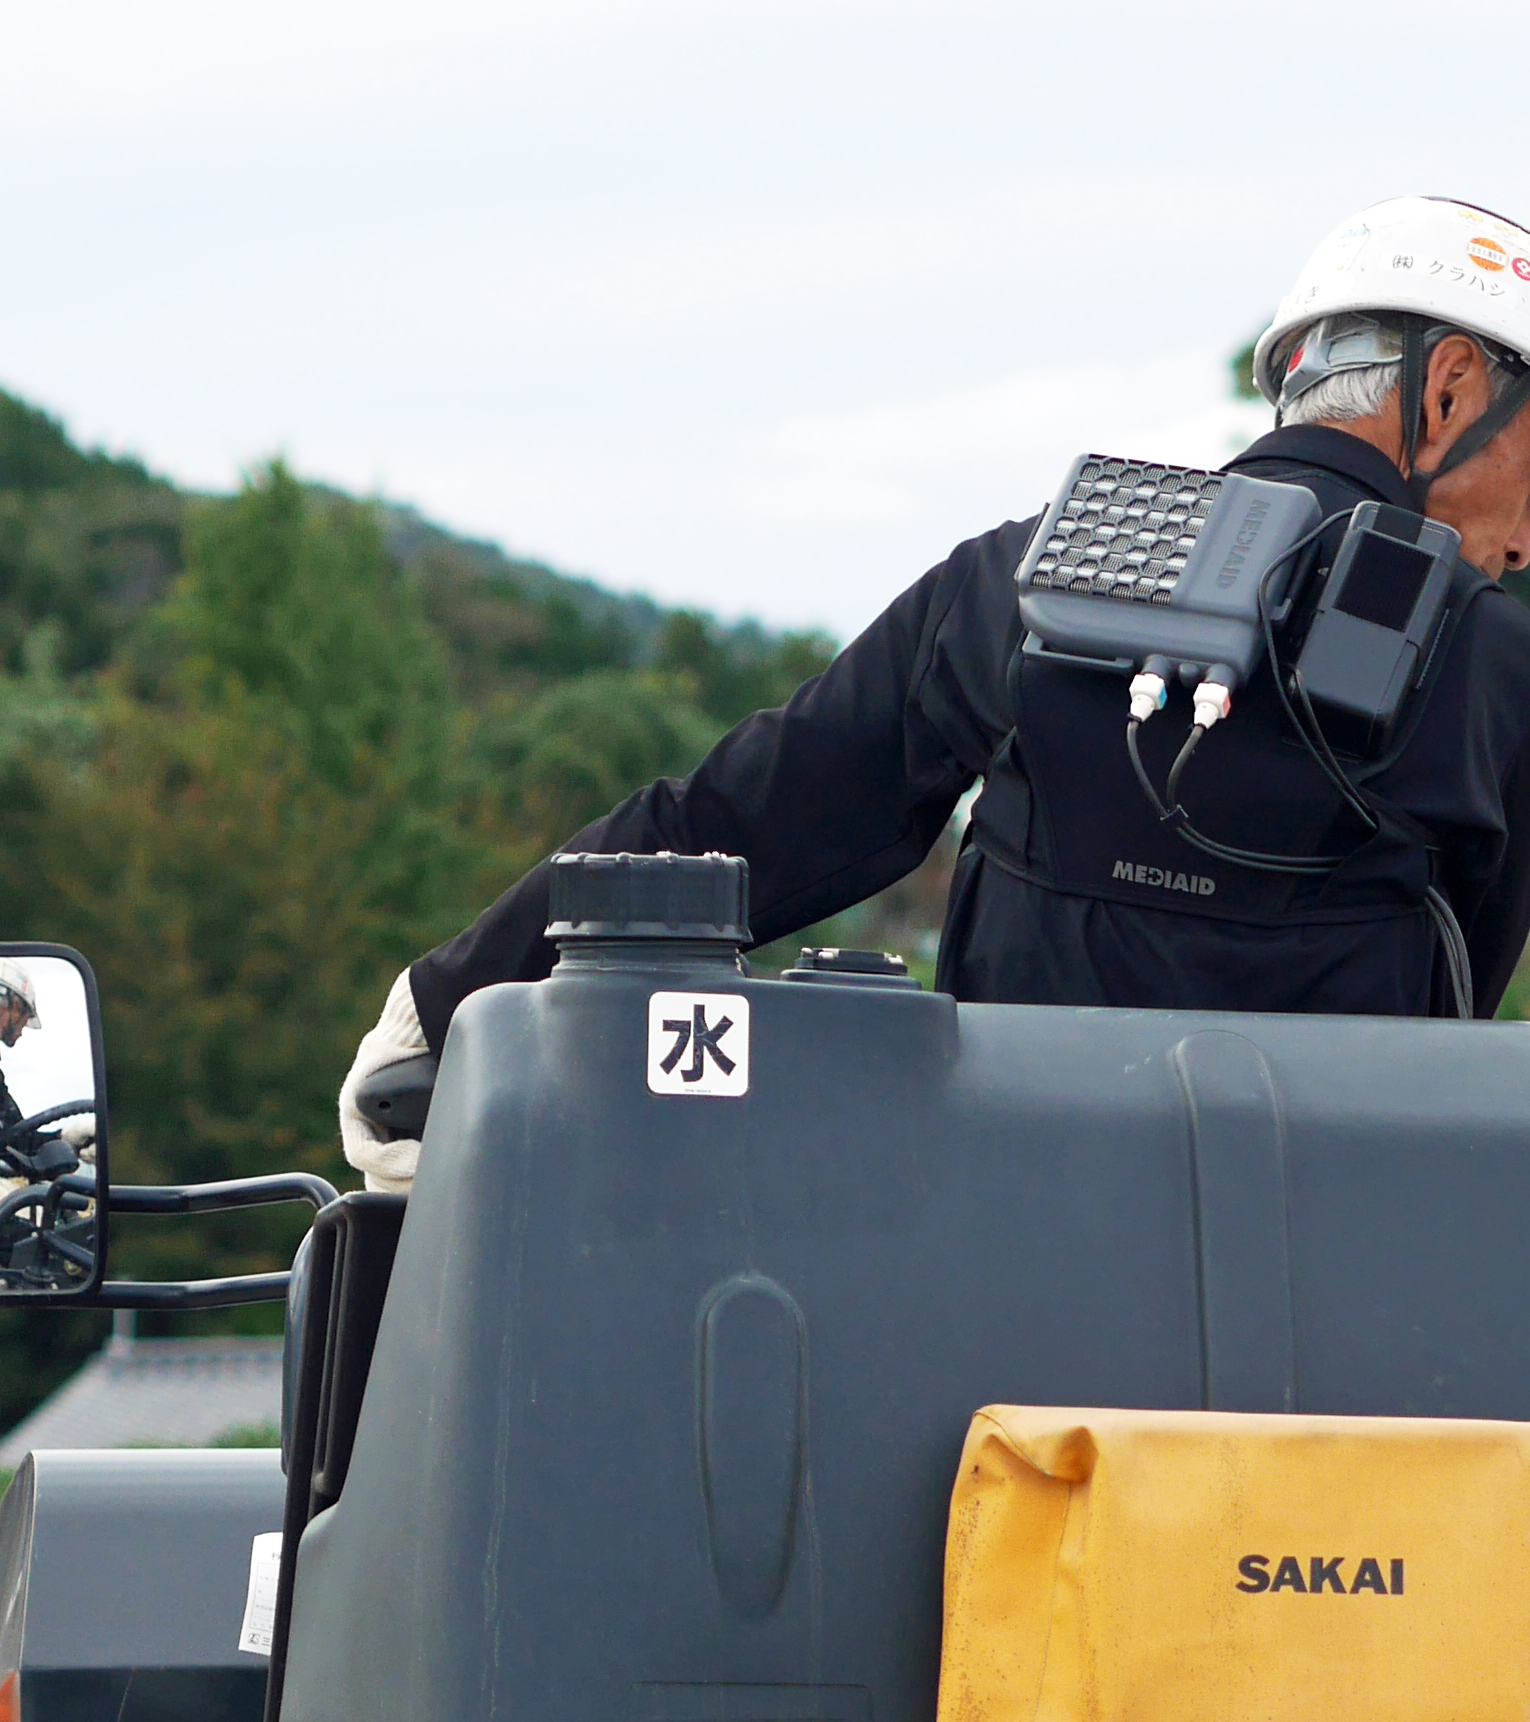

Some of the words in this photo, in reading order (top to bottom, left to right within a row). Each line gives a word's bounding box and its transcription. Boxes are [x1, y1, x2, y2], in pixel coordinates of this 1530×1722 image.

[1428, 260, 1505, 297] クラハシ
[1216, 499, 1271, 590] MEDIAID
[1112, 860, 1216, 896] MEDIAID
[659, 1003, 737, 1083] 水
[1235, 1555, 1404, 1596] SAKAI
